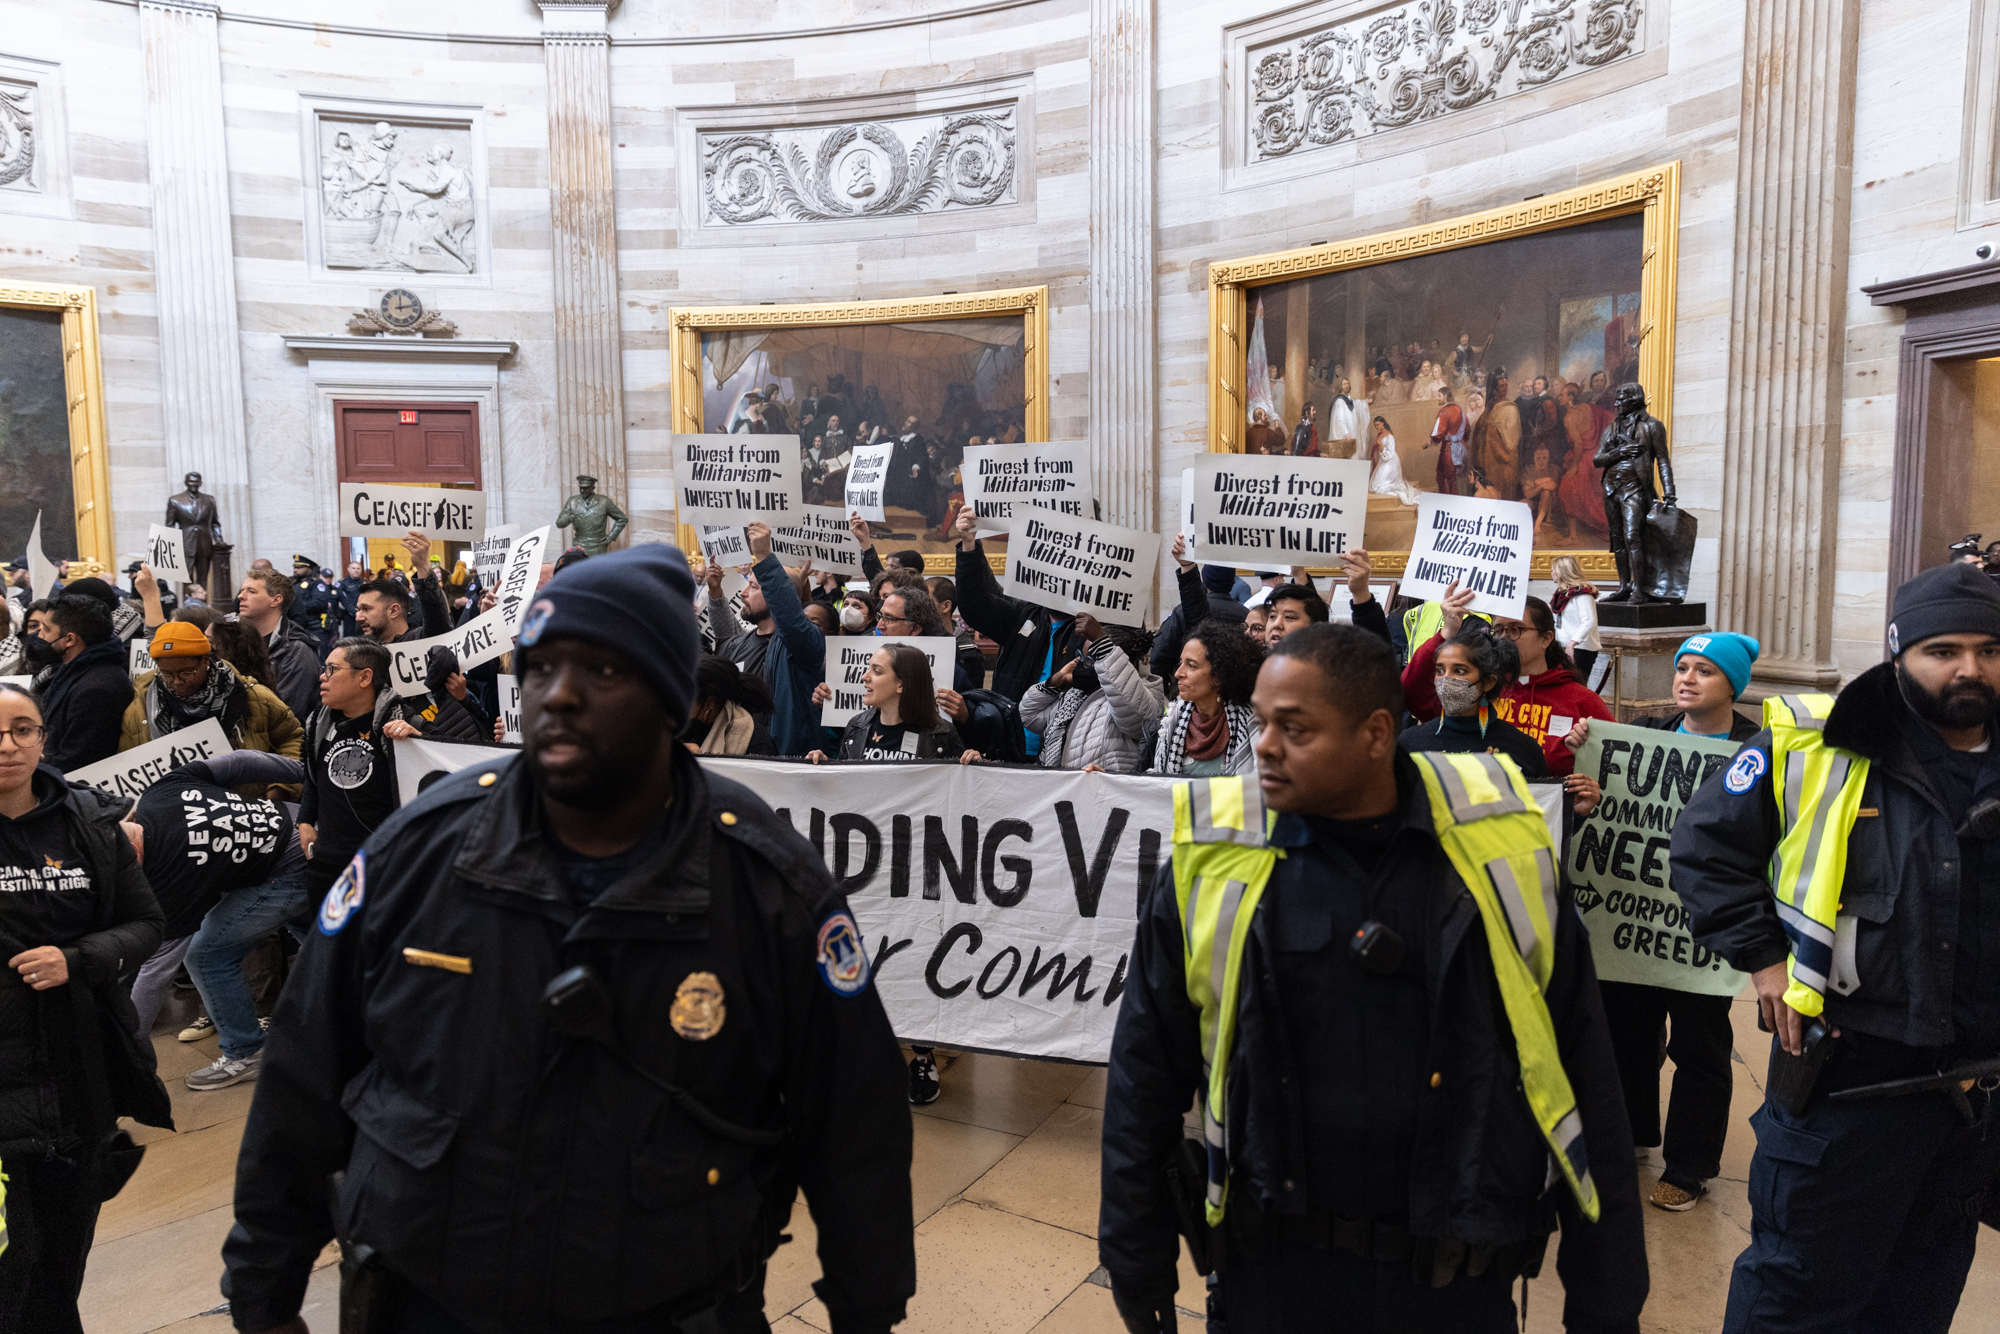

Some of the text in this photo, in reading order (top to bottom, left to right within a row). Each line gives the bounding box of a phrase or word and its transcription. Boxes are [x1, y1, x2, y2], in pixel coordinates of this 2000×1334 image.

[401, 411, 417, 423] EXIT
[686, 444, 780, 464] Divest from
[979, 456, 1073, 475] Divest from
[684, 487, 789, 511] INVEST IN LIFE
[1214, 472, 1343, 498] Divest from
[815, 513, 850, 531] from
[1208, 522, 1275, 549] INVEST
[1280, 525, 1301, 551] IN
[1305, 527, 1347, 555] LIFE
[1432, 509, 1519, 542] Divest from
[771, 537, 856, 565] INVEST IN LIFE
[1025, 519, 1135, 563] Divest from
[1015, 560, 1134, 612] INVEST IN LIFE
[1414, 557, 1516, 600] INVEST IN LIFE
[356, 739, 374, 752] CITY
[181, 789, 209, 866] JEWS
[207, 798, 234, 853] SAY
[225, 791, 251, 864] CEASE
[246, 803, 269, 849] FIRE
[1613, 921, 1723, 971] GREED!
